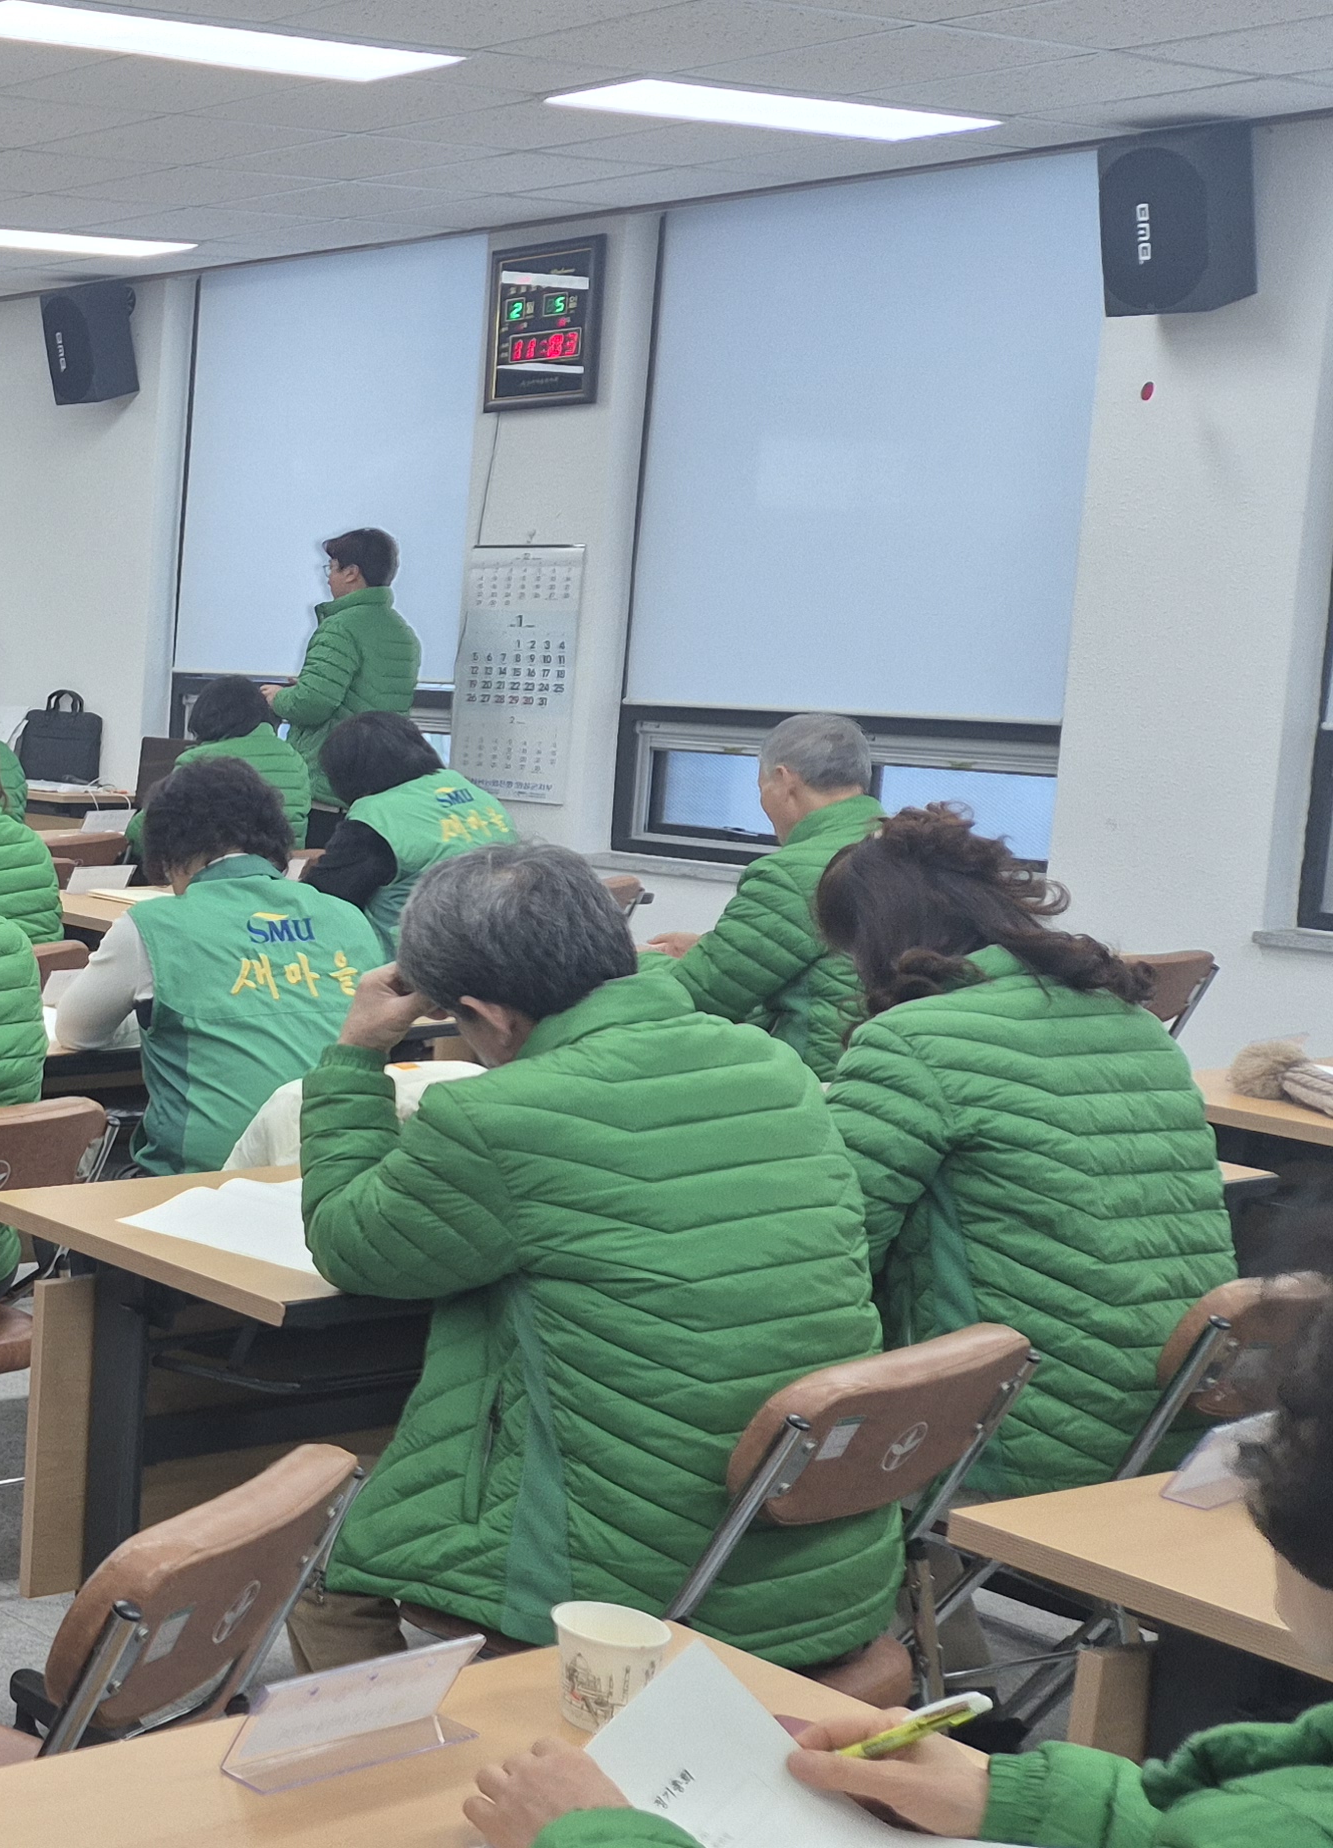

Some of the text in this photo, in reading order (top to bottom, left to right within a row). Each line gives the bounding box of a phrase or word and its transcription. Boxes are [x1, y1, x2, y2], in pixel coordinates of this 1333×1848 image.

[436, 787, 475, 808] SMU
[439, 806, 509, 842] 새마을
[247, 916, 316, 944] SMU
[230, 950, 359, 999] 새마을
[653, 1768, 695, 1810] 정기총회
